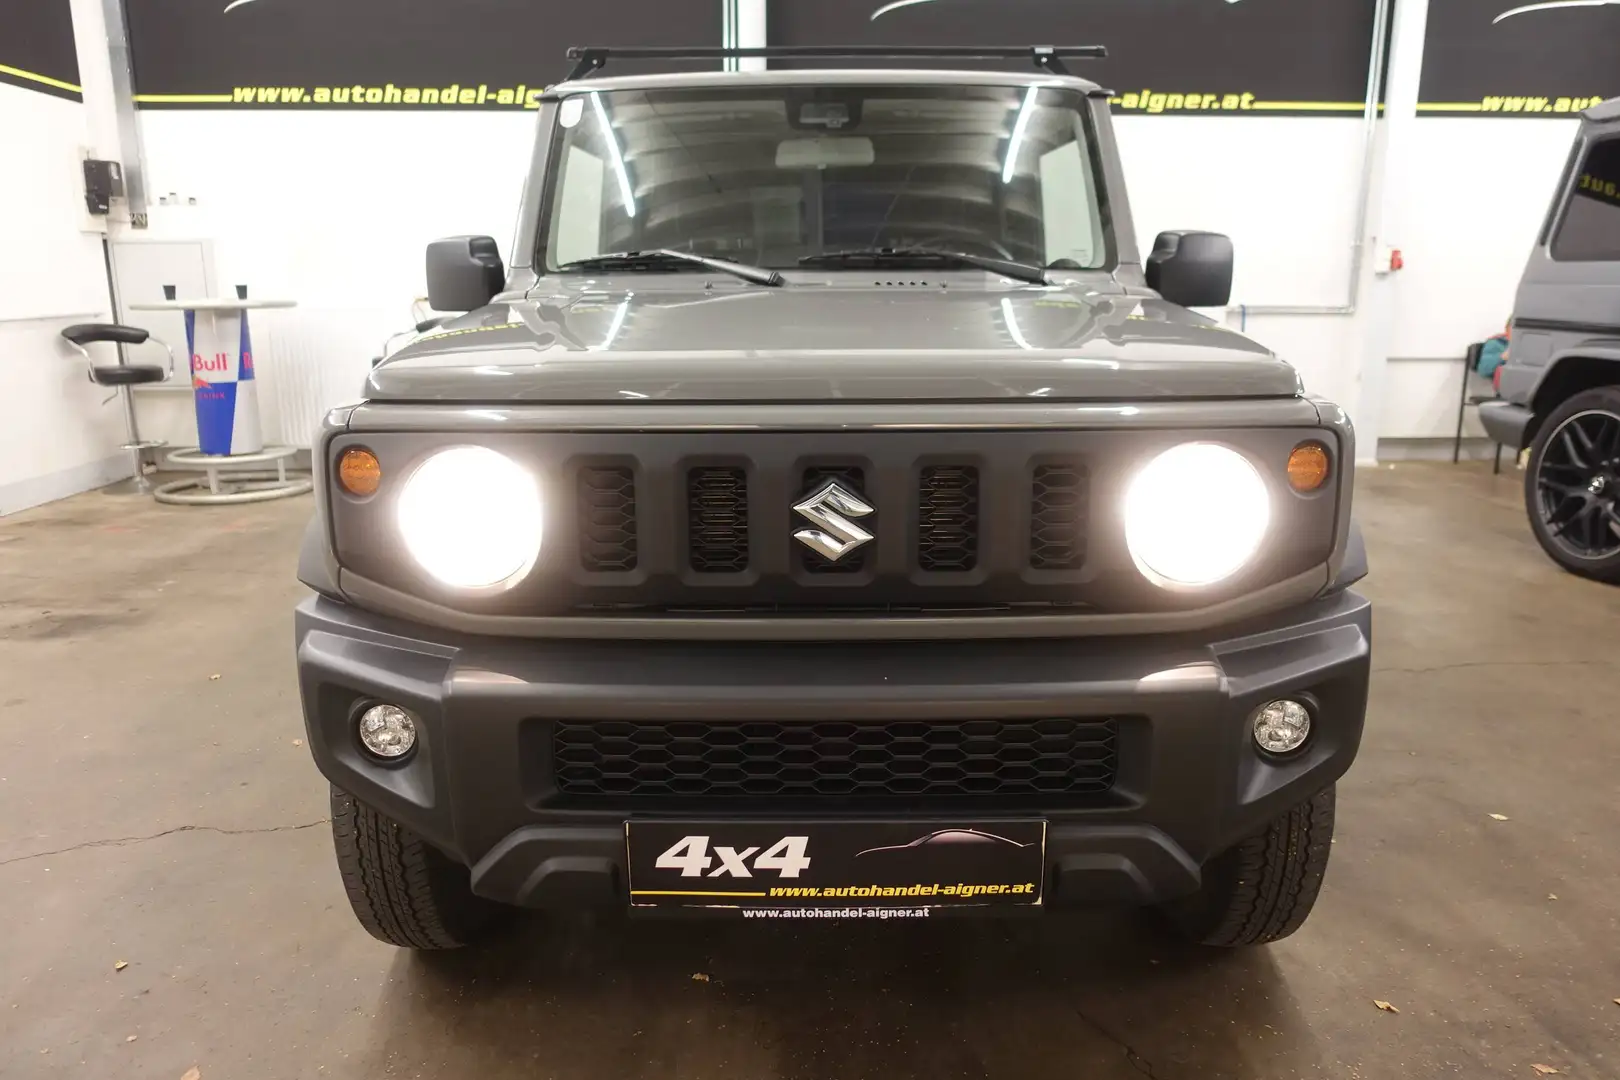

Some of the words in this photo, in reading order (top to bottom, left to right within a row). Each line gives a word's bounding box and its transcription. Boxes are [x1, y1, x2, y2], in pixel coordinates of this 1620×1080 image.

[1106, 89, 1255, 113] -aigner.at
[192, 352, 227, 371] Bull
[655, 836, 811, 878] 4x4
[769, 882, 1035, 898] www.autohandel-aigner.at
[742, 907, 930, 919] www.autohandel-aigner.at
